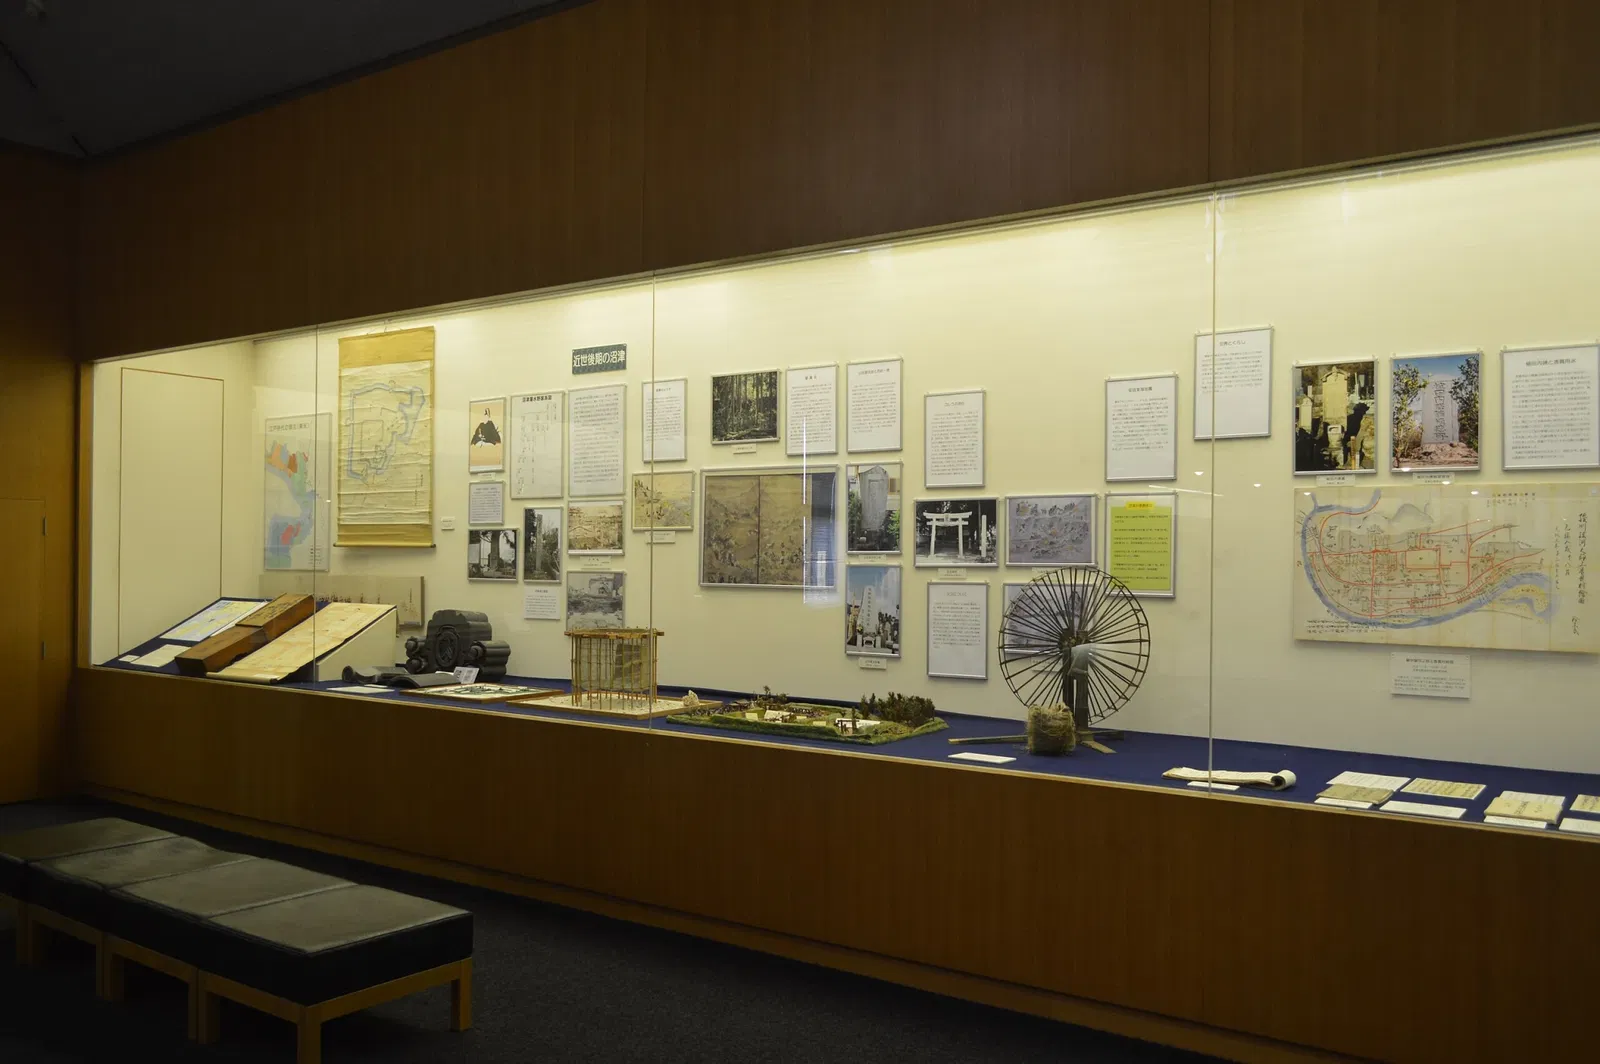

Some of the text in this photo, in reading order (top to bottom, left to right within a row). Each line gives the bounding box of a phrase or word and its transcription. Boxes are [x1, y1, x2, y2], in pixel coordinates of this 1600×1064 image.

[573, 349, 626, 368] 近世後期の沼津
